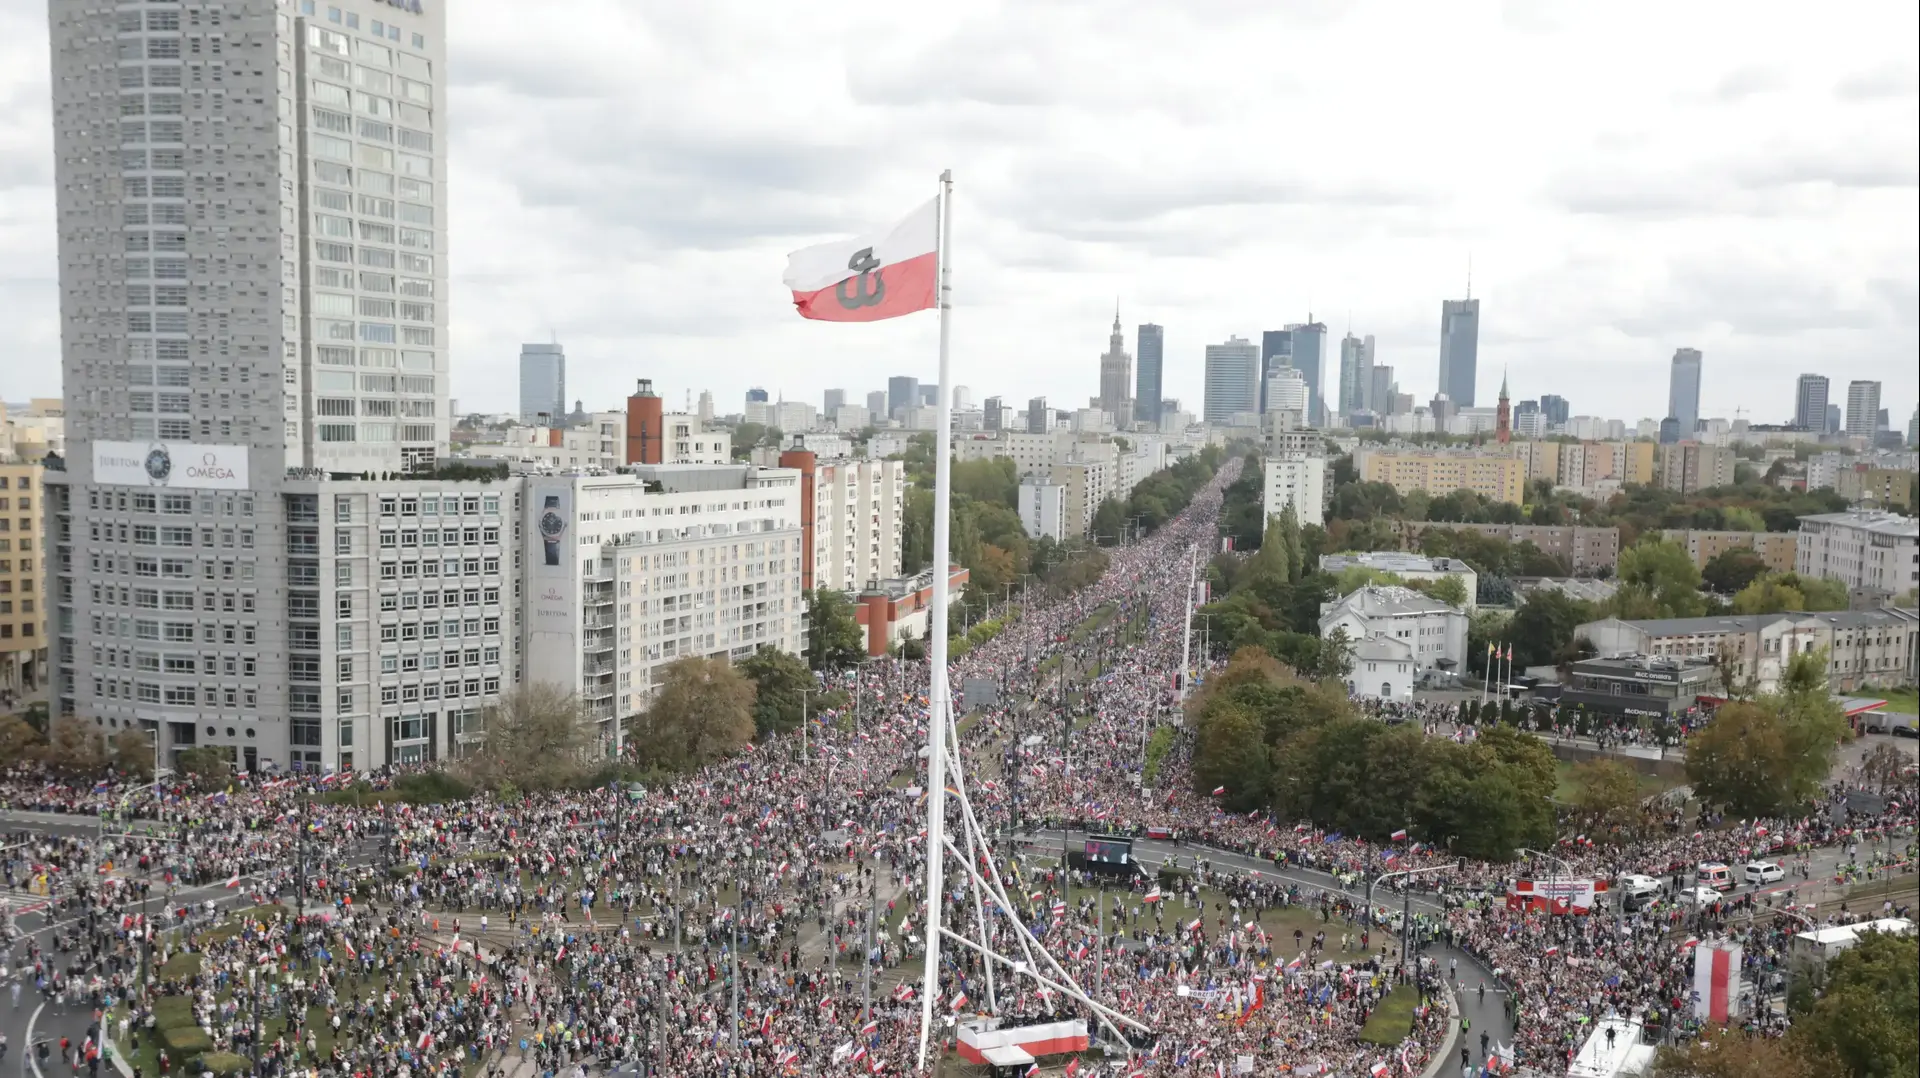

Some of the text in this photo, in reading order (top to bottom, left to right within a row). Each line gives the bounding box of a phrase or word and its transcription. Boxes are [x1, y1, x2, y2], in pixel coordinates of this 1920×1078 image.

[99, 455, 140, 468] JUBITOM
[186, 466, 235, 480] OMEGA
[537, 609, 568, 617] JUBITOM
